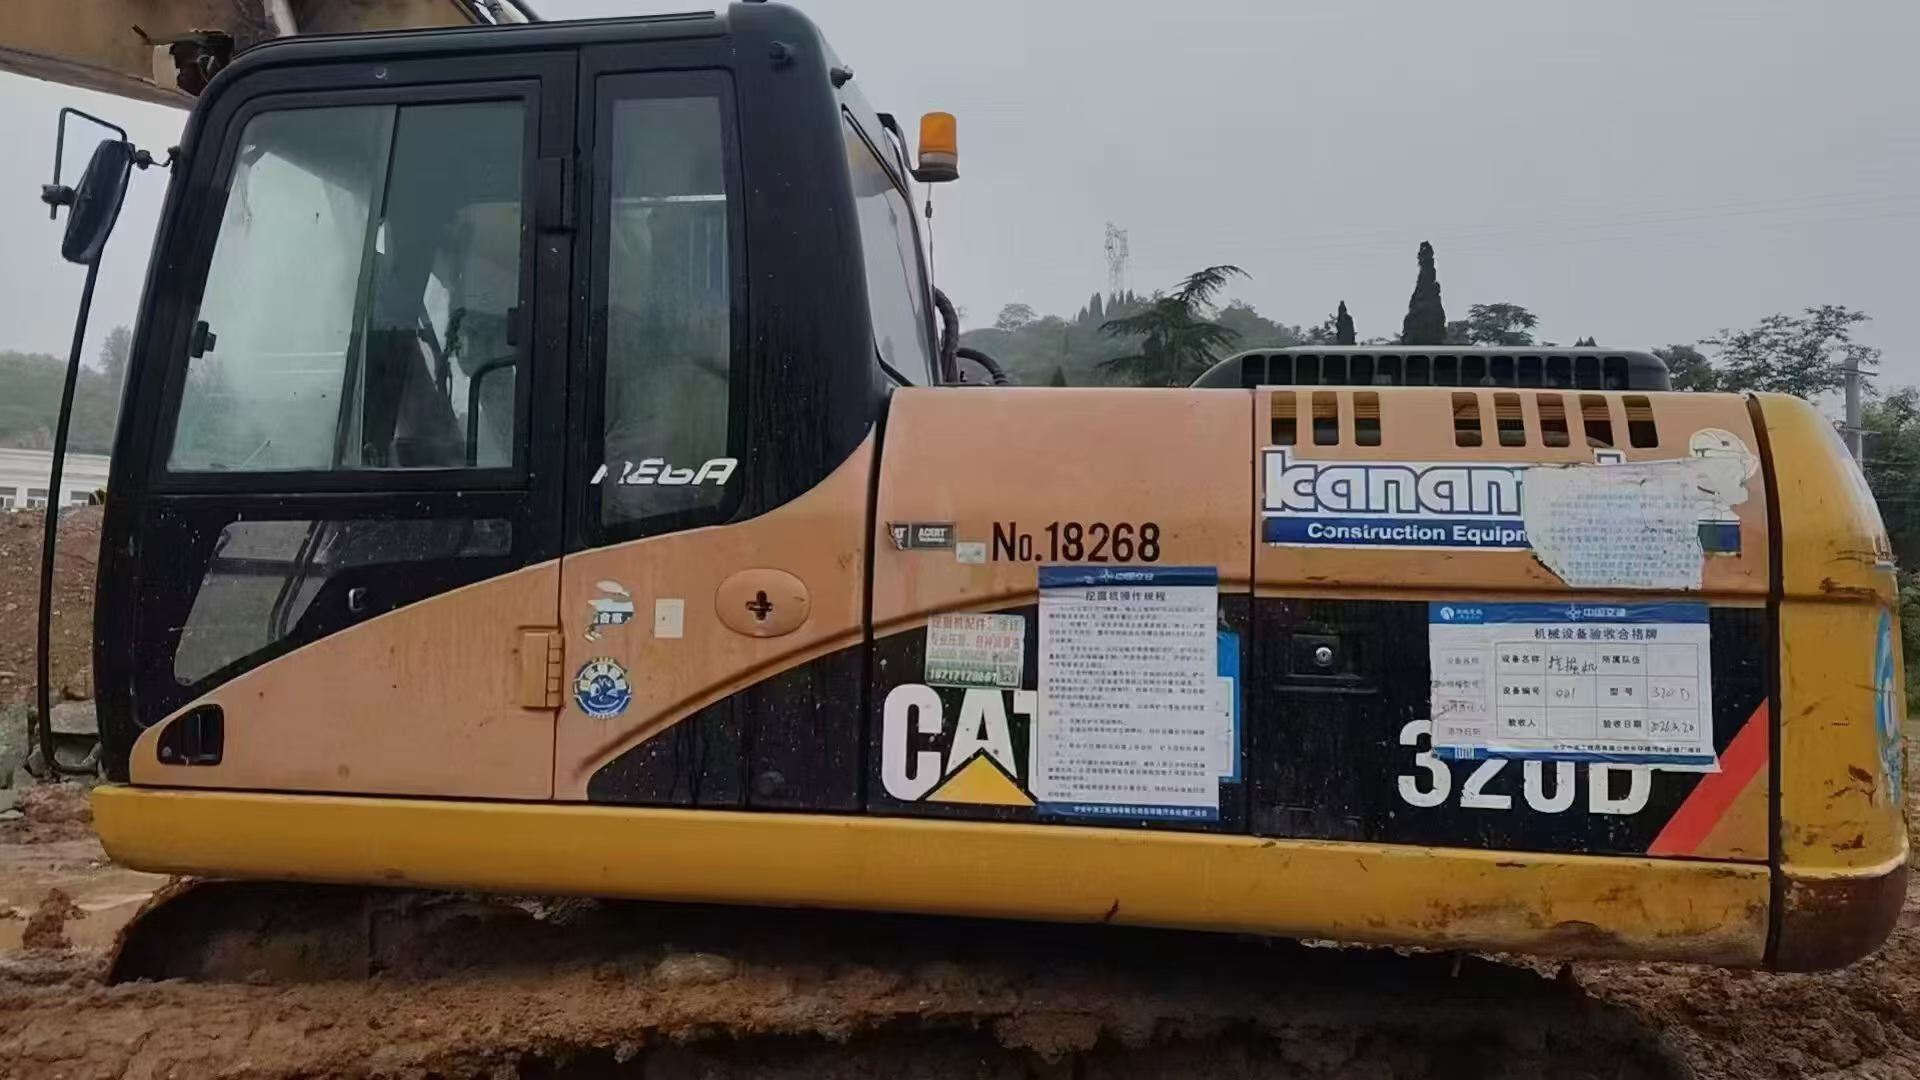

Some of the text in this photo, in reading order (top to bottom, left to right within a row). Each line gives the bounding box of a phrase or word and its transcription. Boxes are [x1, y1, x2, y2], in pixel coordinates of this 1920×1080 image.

[1307, 523, 1445, 540] Construction
[992, 521, 1161, 563] No.18268
[1534, 628, 1658, 641] 机械设备验收合格牌
[1502, 655, 1540, 663] 设备名称
[1602, 655, 1640, 664] 所属队伍
[1503, 687, 1540, 695] 设备编号
[1609, 687, 1633, 696] 型号
[1508, 718, 1536, 727] 验收人
[1603, 719, 1642, 728] 验收日期
[1398, 720, 1651, 814] 320D
